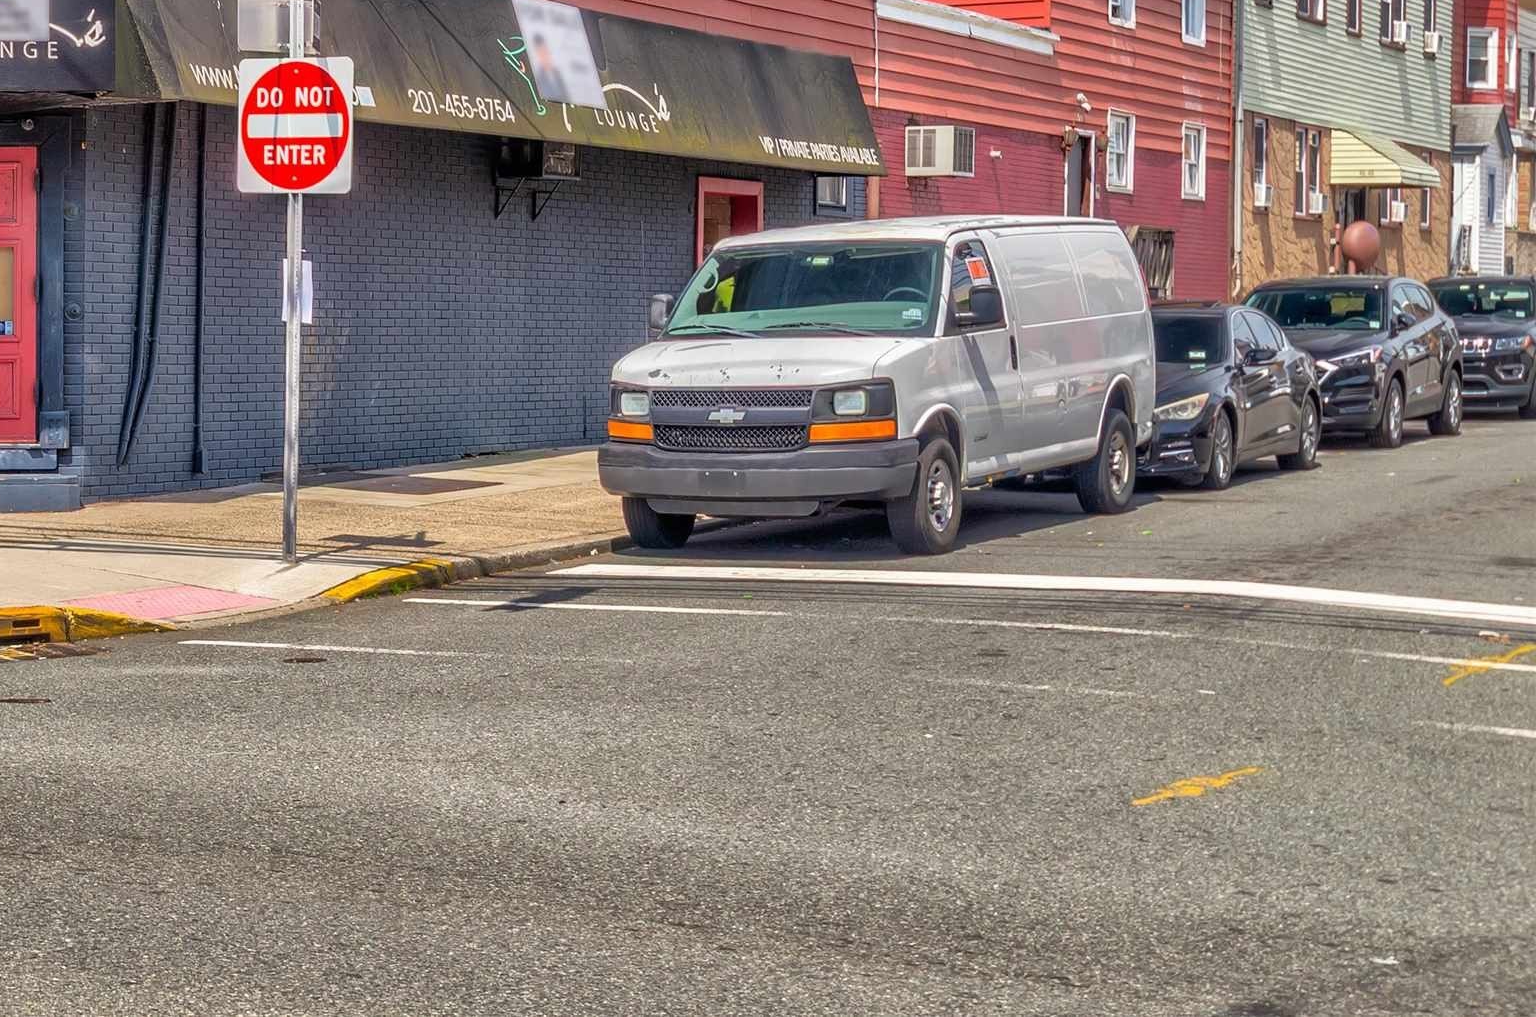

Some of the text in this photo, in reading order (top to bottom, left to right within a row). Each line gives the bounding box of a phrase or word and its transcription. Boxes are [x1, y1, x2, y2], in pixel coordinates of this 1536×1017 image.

[256, 87, 284, 109] DO
[295, 86, 335, 108] NOT
[407, 88, 516, 124] 201-455-8754
[594, 108, 660, 134] LOUNGE
[263, 144, 327, 166] ENTER
[758, 135, 774, 155] VIP
[779, 139, 813, 160] PRIVATE
[809, 142, 842, 163] PARTIES
[840, 146, 880, 166] AVAILABLE
